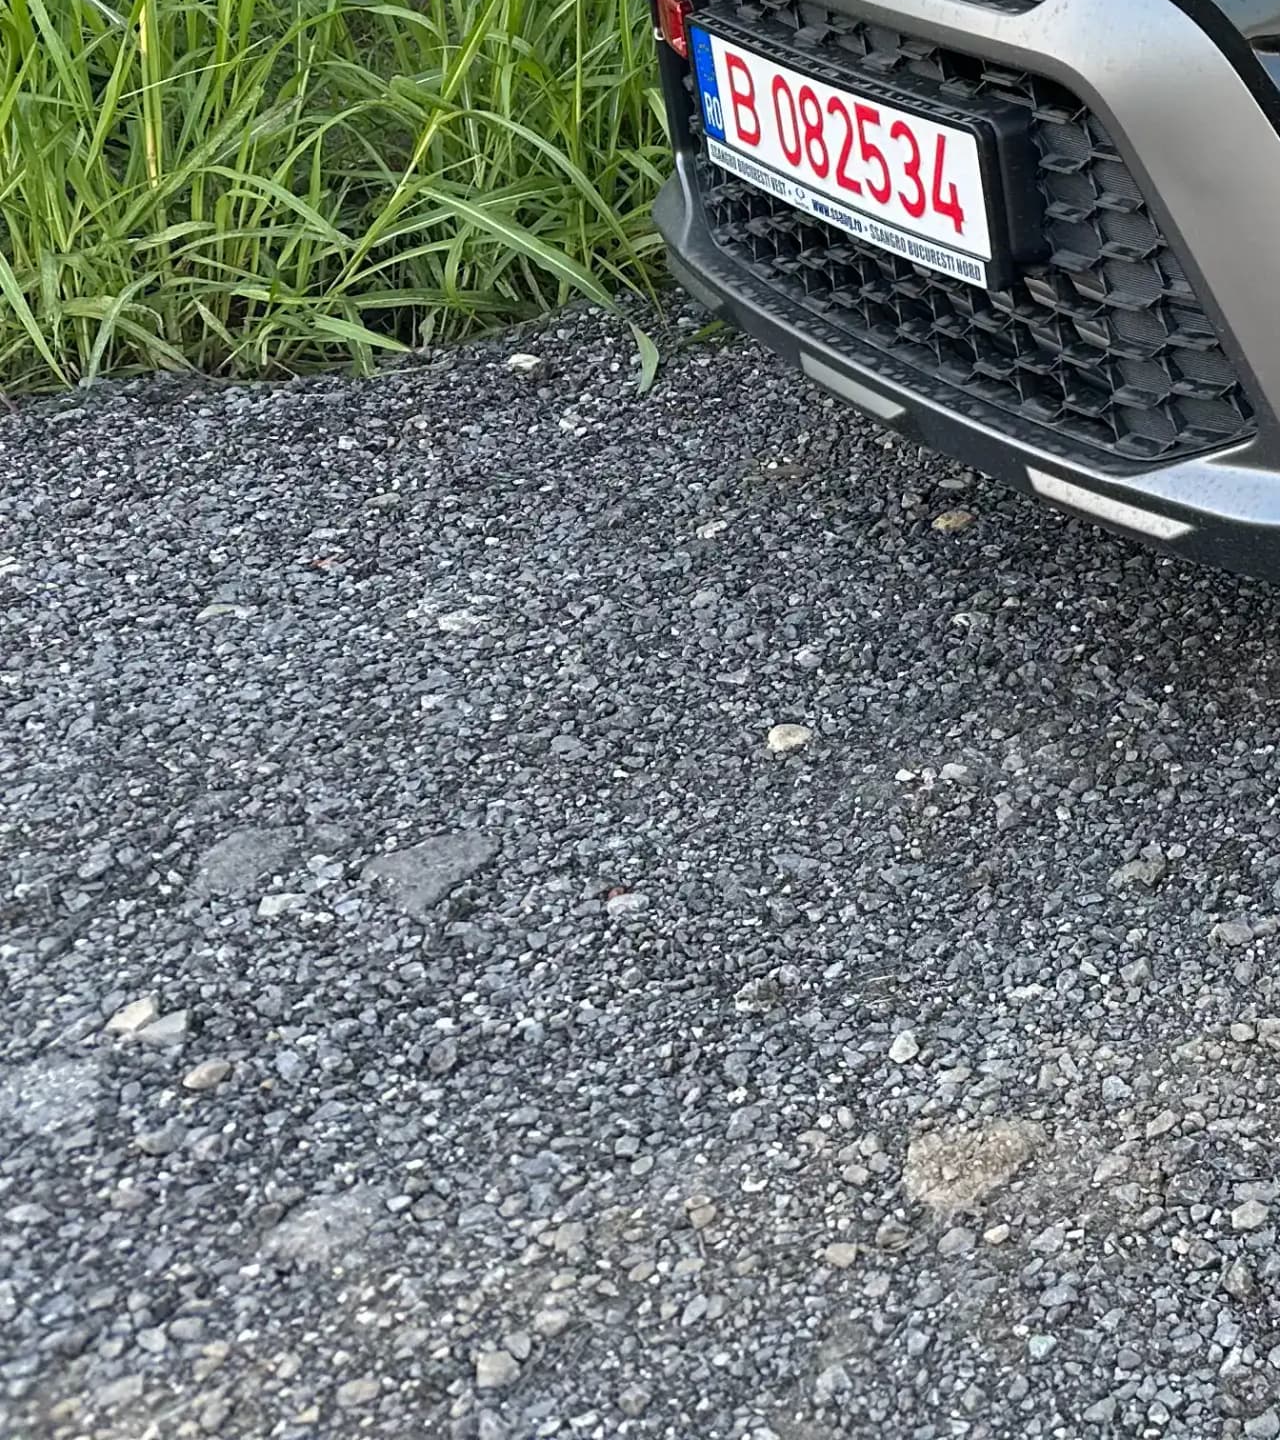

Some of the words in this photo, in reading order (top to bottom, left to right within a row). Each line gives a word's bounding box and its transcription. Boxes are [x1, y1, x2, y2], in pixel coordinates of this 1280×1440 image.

[704, 91, 723, 131] RO
[725, 51, 760, 147] B
[772, 75, 964, 235] 082534
